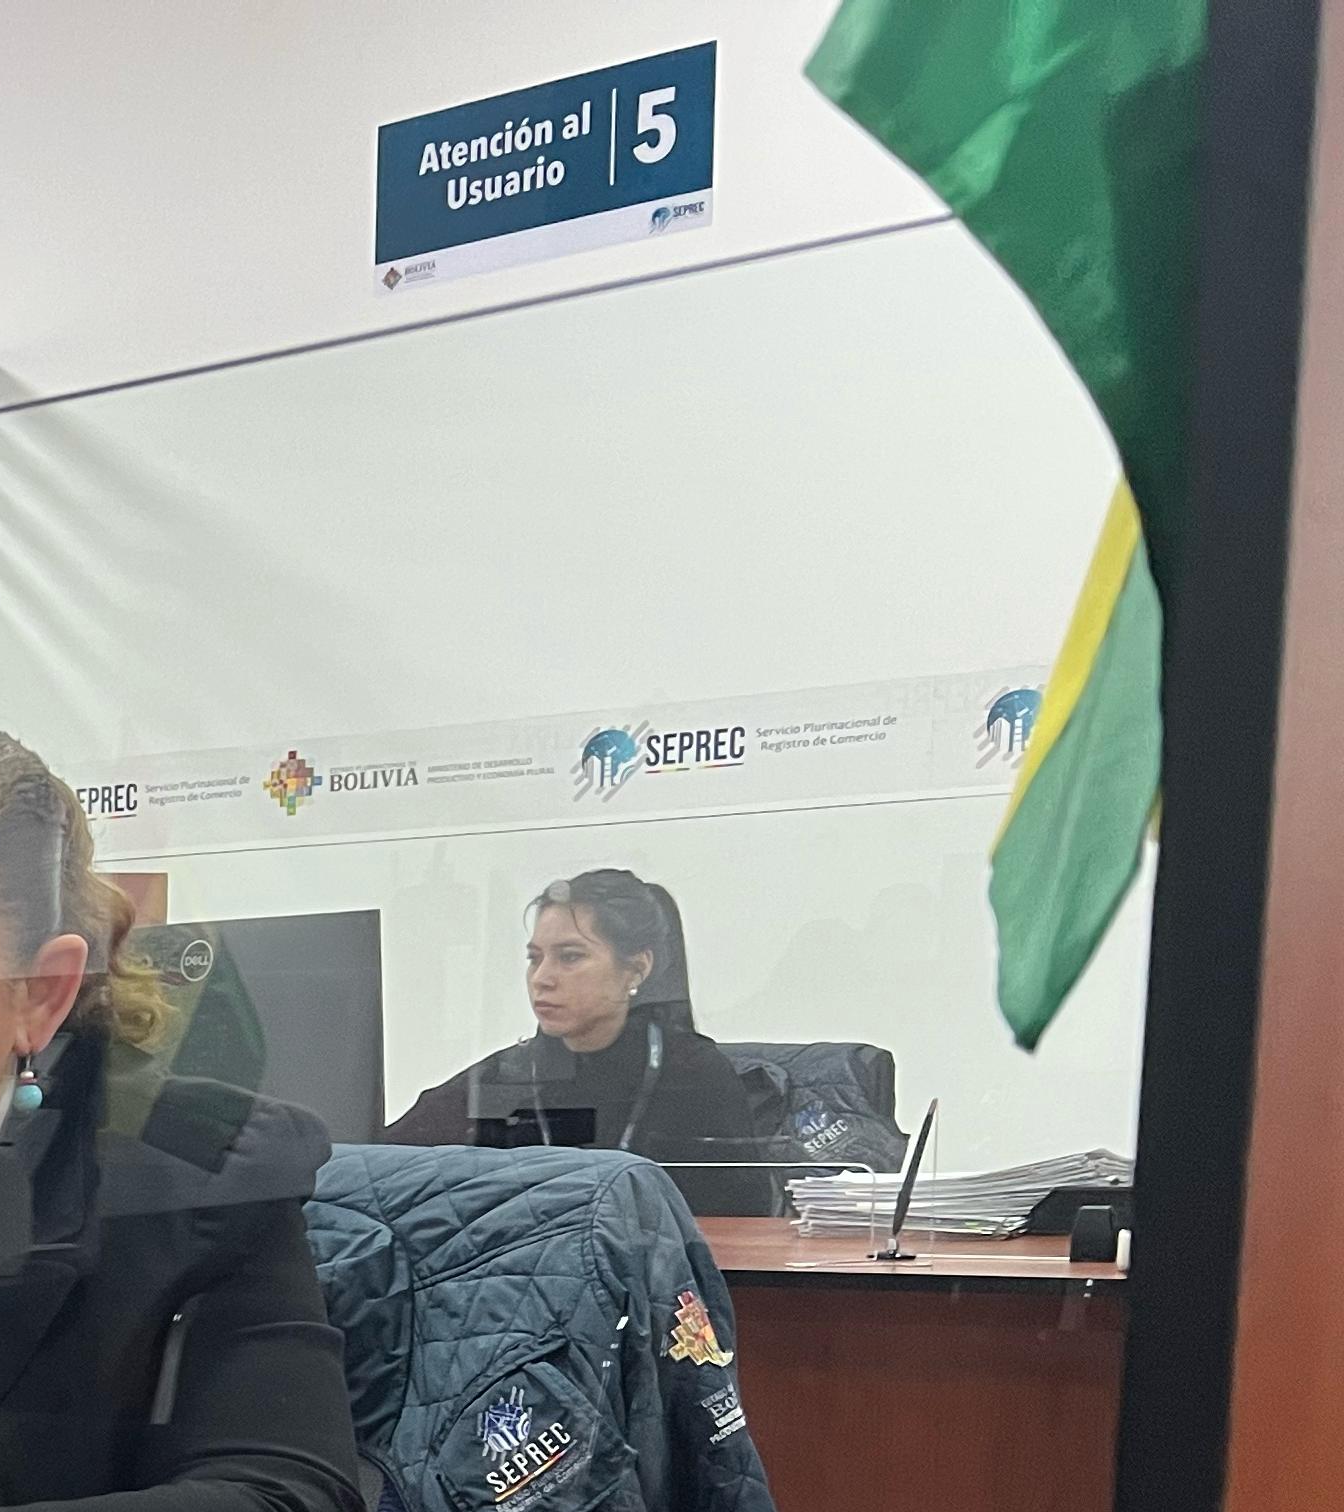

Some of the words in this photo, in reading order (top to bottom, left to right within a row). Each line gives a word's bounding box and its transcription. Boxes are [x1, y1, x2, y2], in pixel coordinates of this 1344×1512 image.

[418, 117, 553, 176] Atención
[562, 101, 592, 139] al
[633, 86, 677, 164] 5
[446, 155, 566, 210] Usuario
[645, 726, 745, 767] SEPREC
[756, 725, 801, 738] Servicio
[882, 715, 898, 726] de
[761, 738, 810, 753] Registro
[812, 736, 828, 747] de
[830, 730, 887, 745] Comercio
[330, 767, 419, 792] BOLIVIA
[803, 1119, 849, 1153] SEPREC
[486, 1422, 571, 1494] SEPREC
